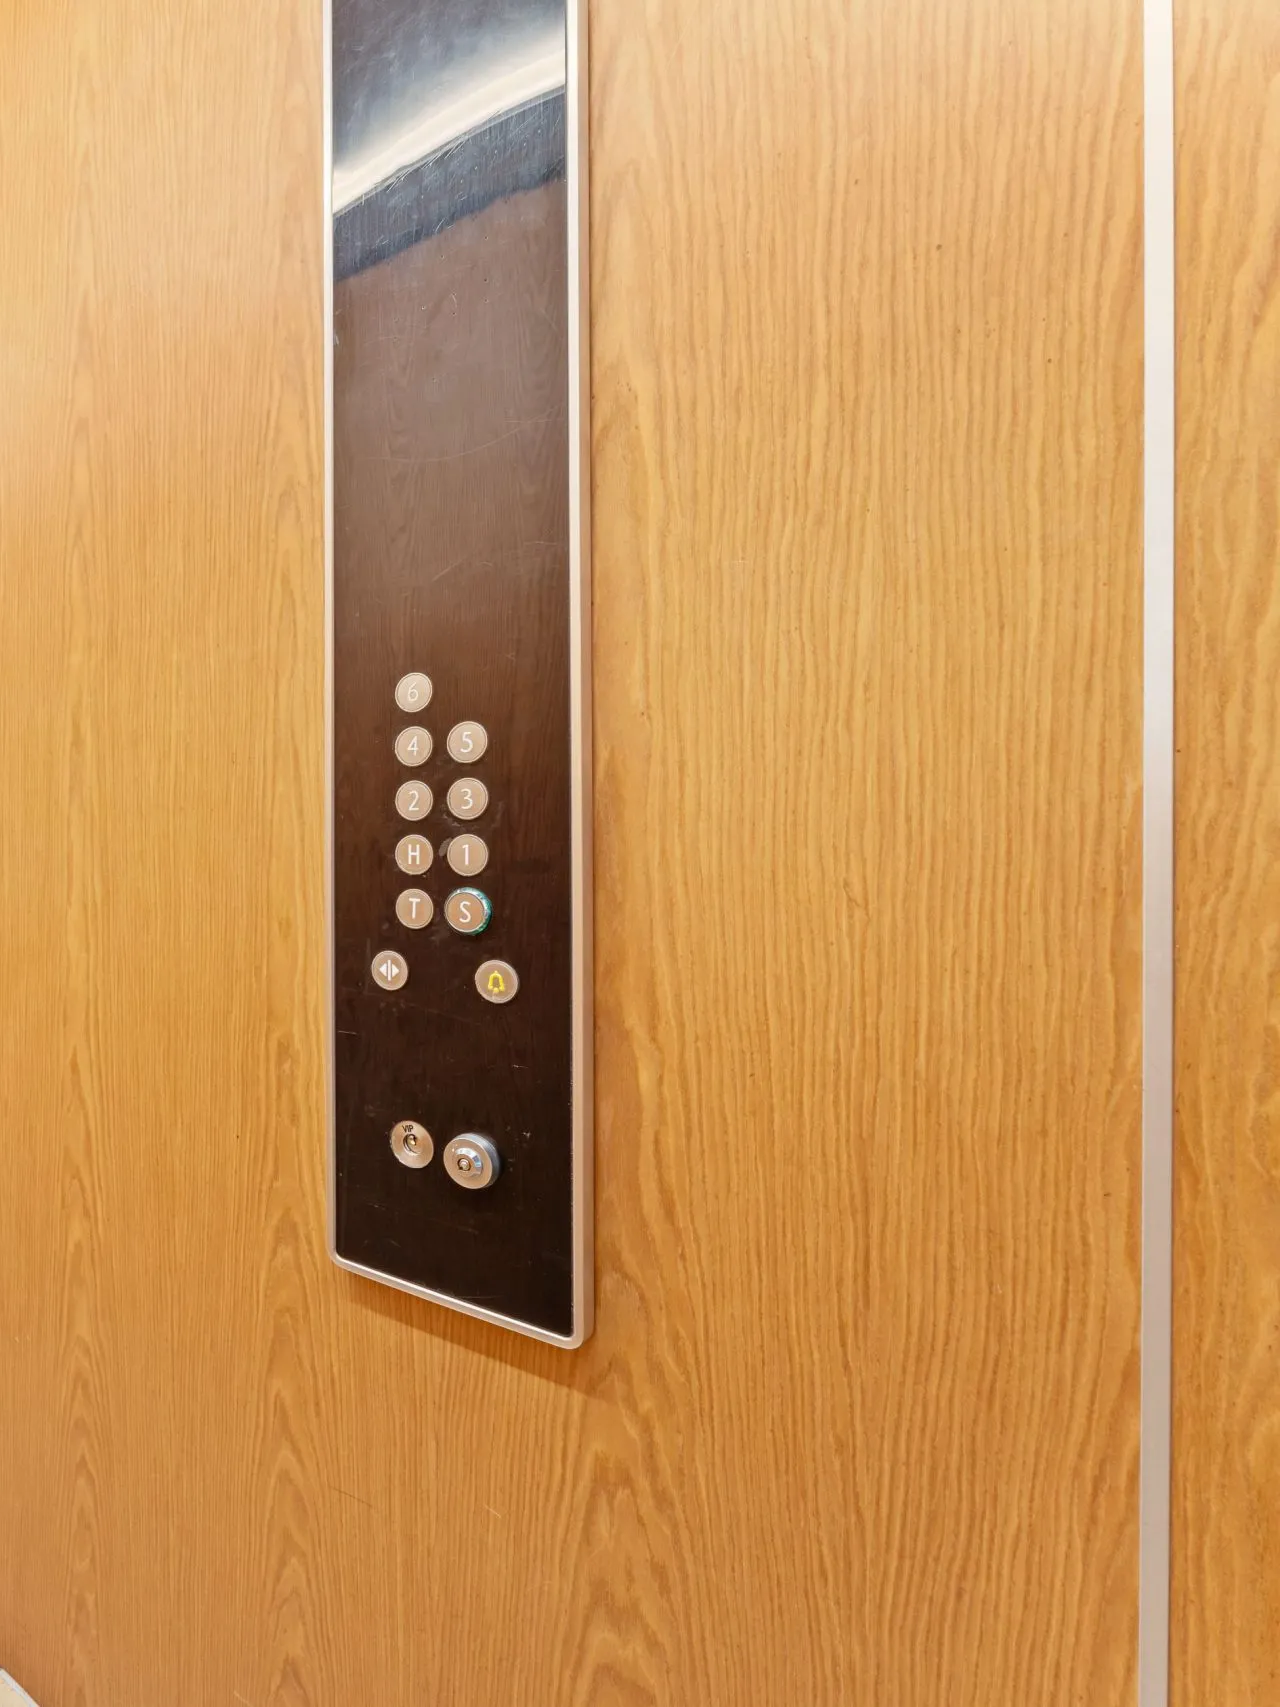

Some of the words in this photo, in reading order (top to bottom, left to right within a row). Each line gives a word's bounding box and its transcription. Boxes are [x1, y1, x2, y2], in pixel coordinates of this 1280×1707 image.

[408, 682, 418, 702] 6
[407, 735, 419, 756] 4
[460, 731, 473, 753] 5
[408, 790, 419, 811] 2
[461, 788, 473, 809] 3
[408, 844, 420, 865] H
[409, 898, 420, 920] T
[459, 901, 471, 923] S
[402, 1124, 414, 1133] VIP
